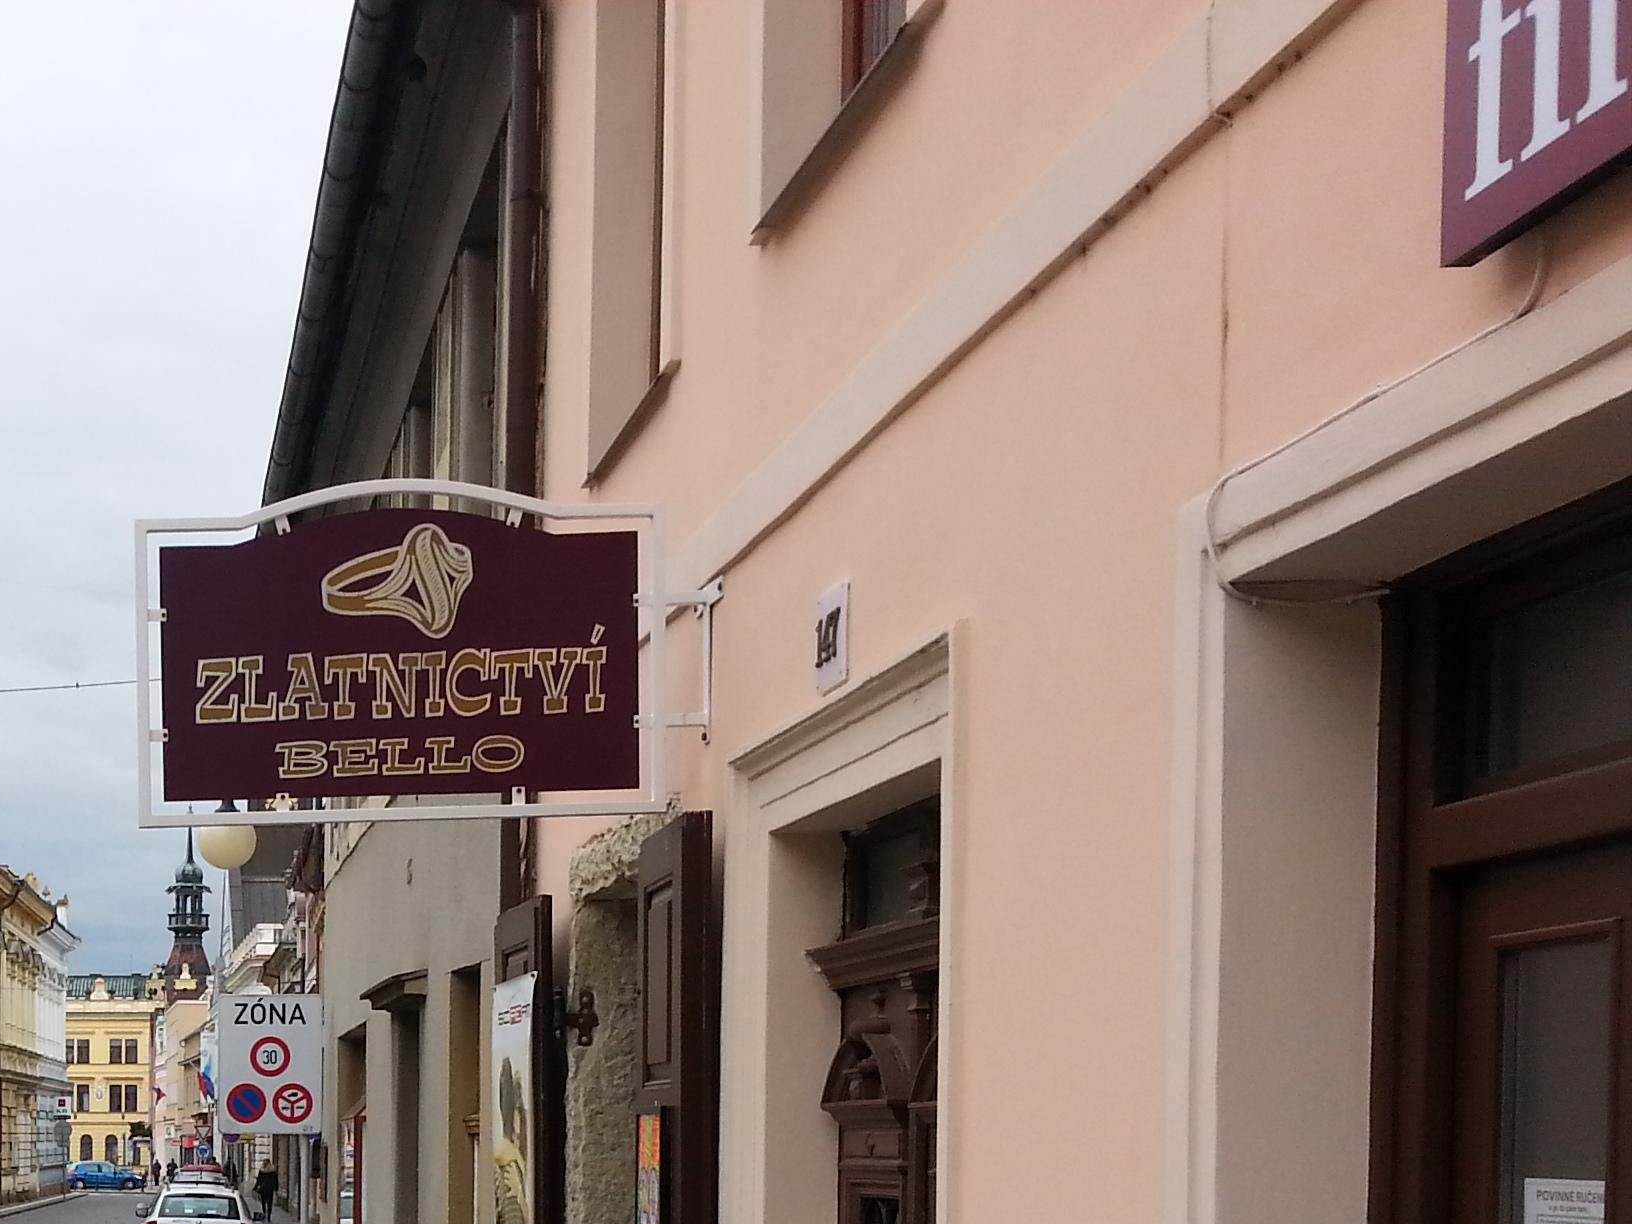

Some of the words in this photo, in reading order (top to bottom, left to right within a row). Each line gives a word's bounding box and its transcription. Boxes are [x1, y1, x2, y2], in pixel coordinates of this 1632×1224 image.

[195, 624, 607, 724] ZLATNICTVÍ
[275, 735, 525, 779] BELLO
[234, 997, 307, 1025] ZÓNA
[262, 1050, 278, 1064] 30
